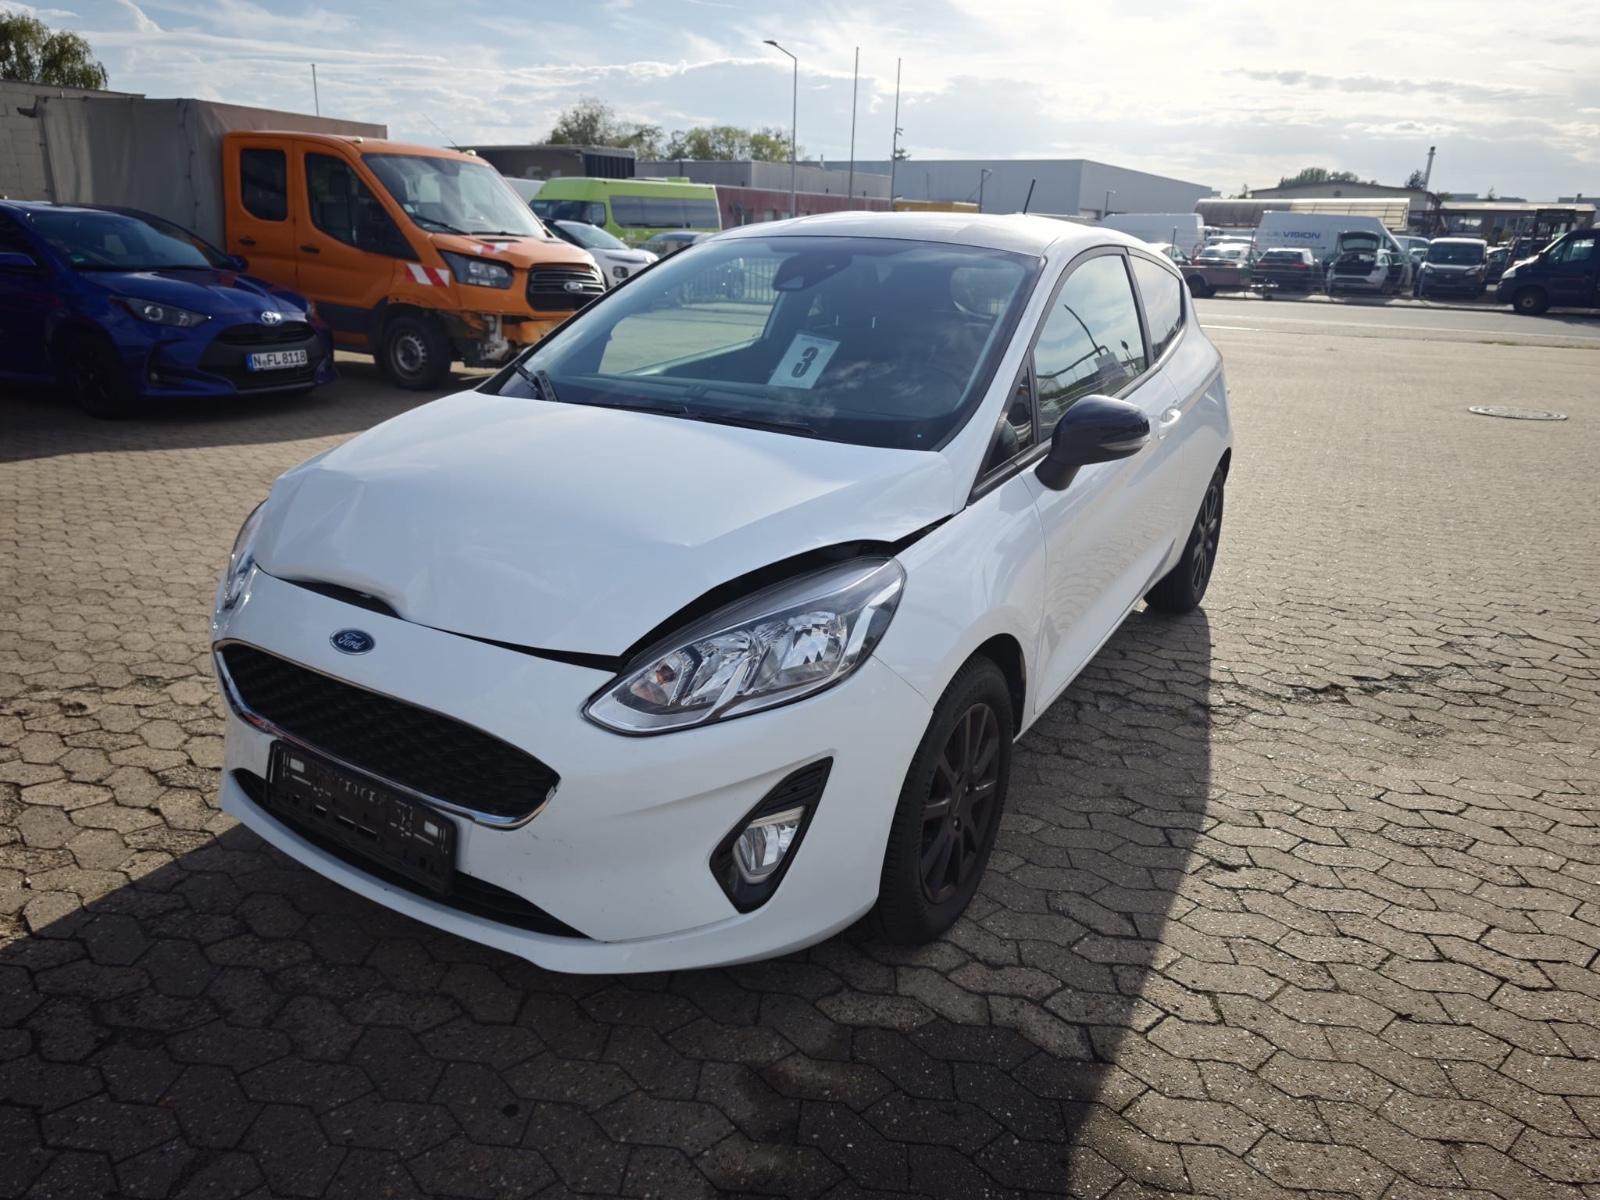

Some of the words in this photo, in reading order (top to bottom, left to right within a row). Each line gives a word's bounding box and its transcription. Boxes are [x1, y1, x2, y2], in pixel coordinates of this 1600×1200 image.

[1283, 231, 1321, 240] VISION
[791, 346, 819, 378] 3
[337, 632, 366, 650] Ford
